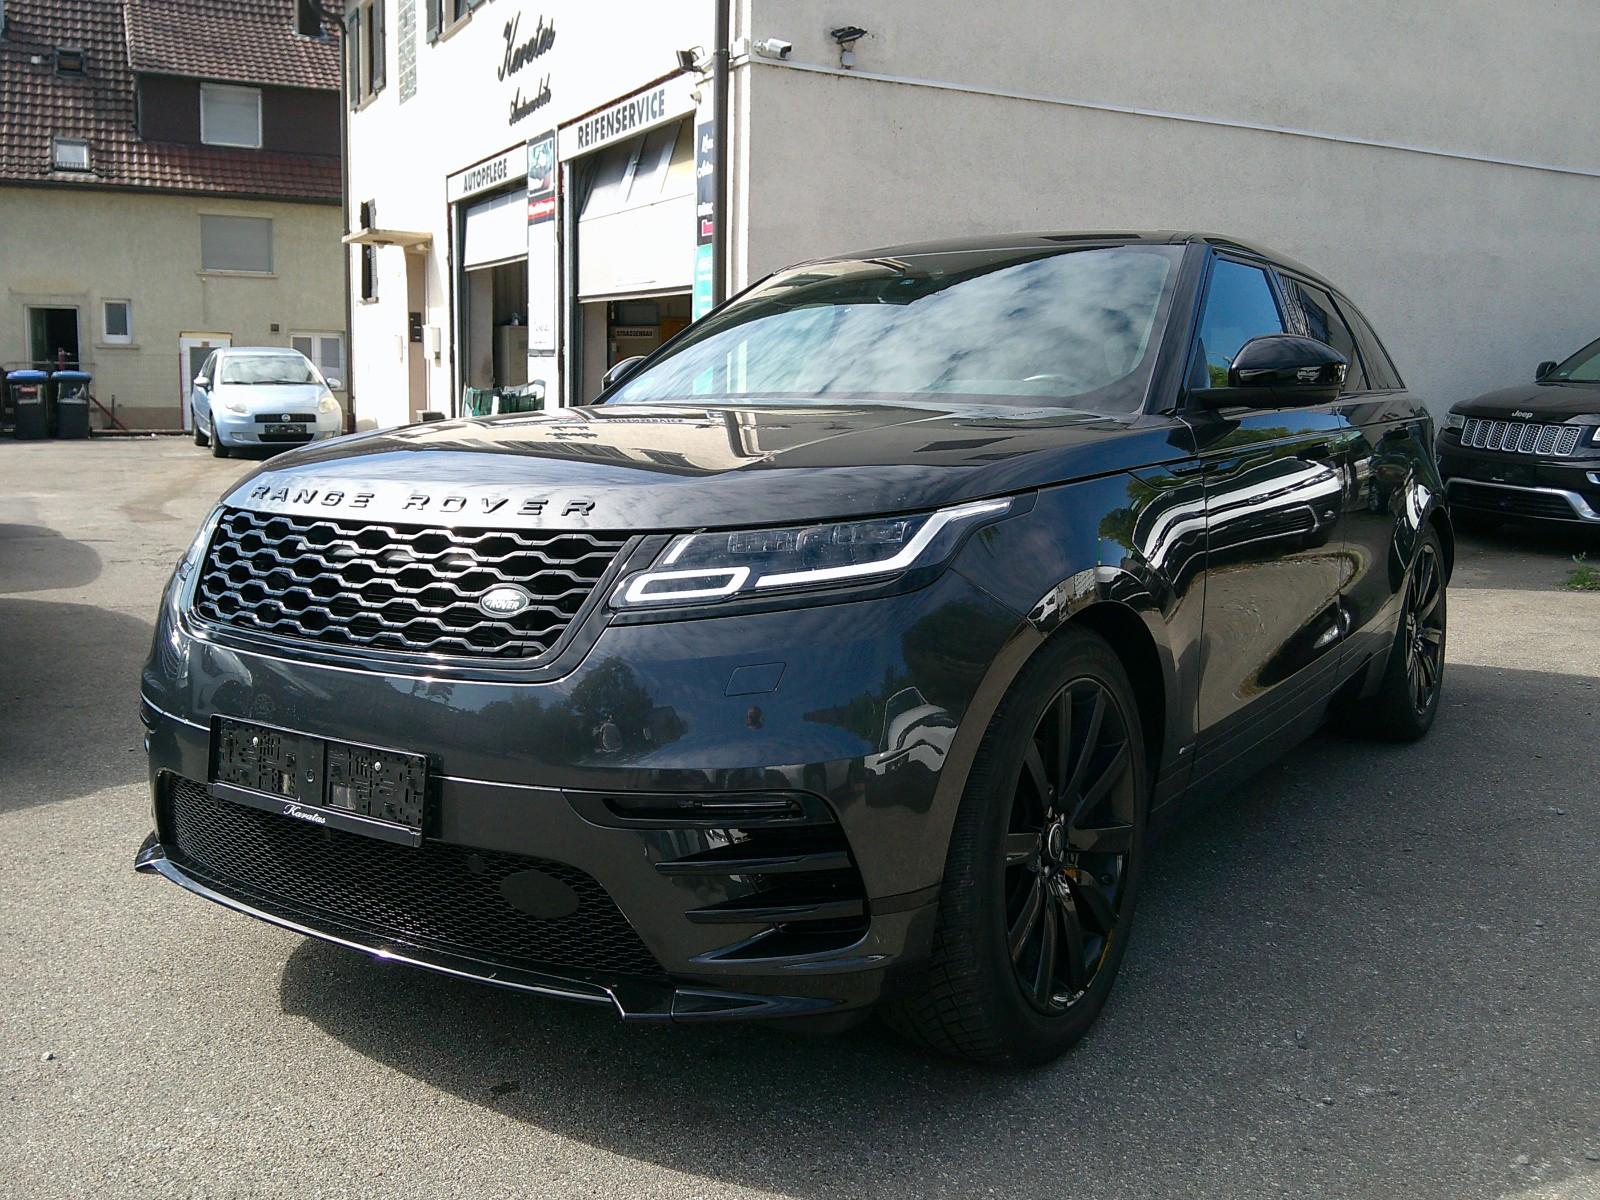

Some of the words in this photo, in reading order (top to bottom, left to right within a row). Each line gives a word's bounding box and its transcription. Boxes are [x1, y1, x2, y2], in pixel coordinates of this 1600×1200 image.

[577, 89, 665, 149] REIFENSERVICE
[463, 158, 507, 193] AUTOPFLEGE
[1511, 409, 1533, 419] Jeep
[251, 486, 375, 508] RANGE
[401, 494, 596, 516] ROVER
[283, 804, 326, 824] Karatas
